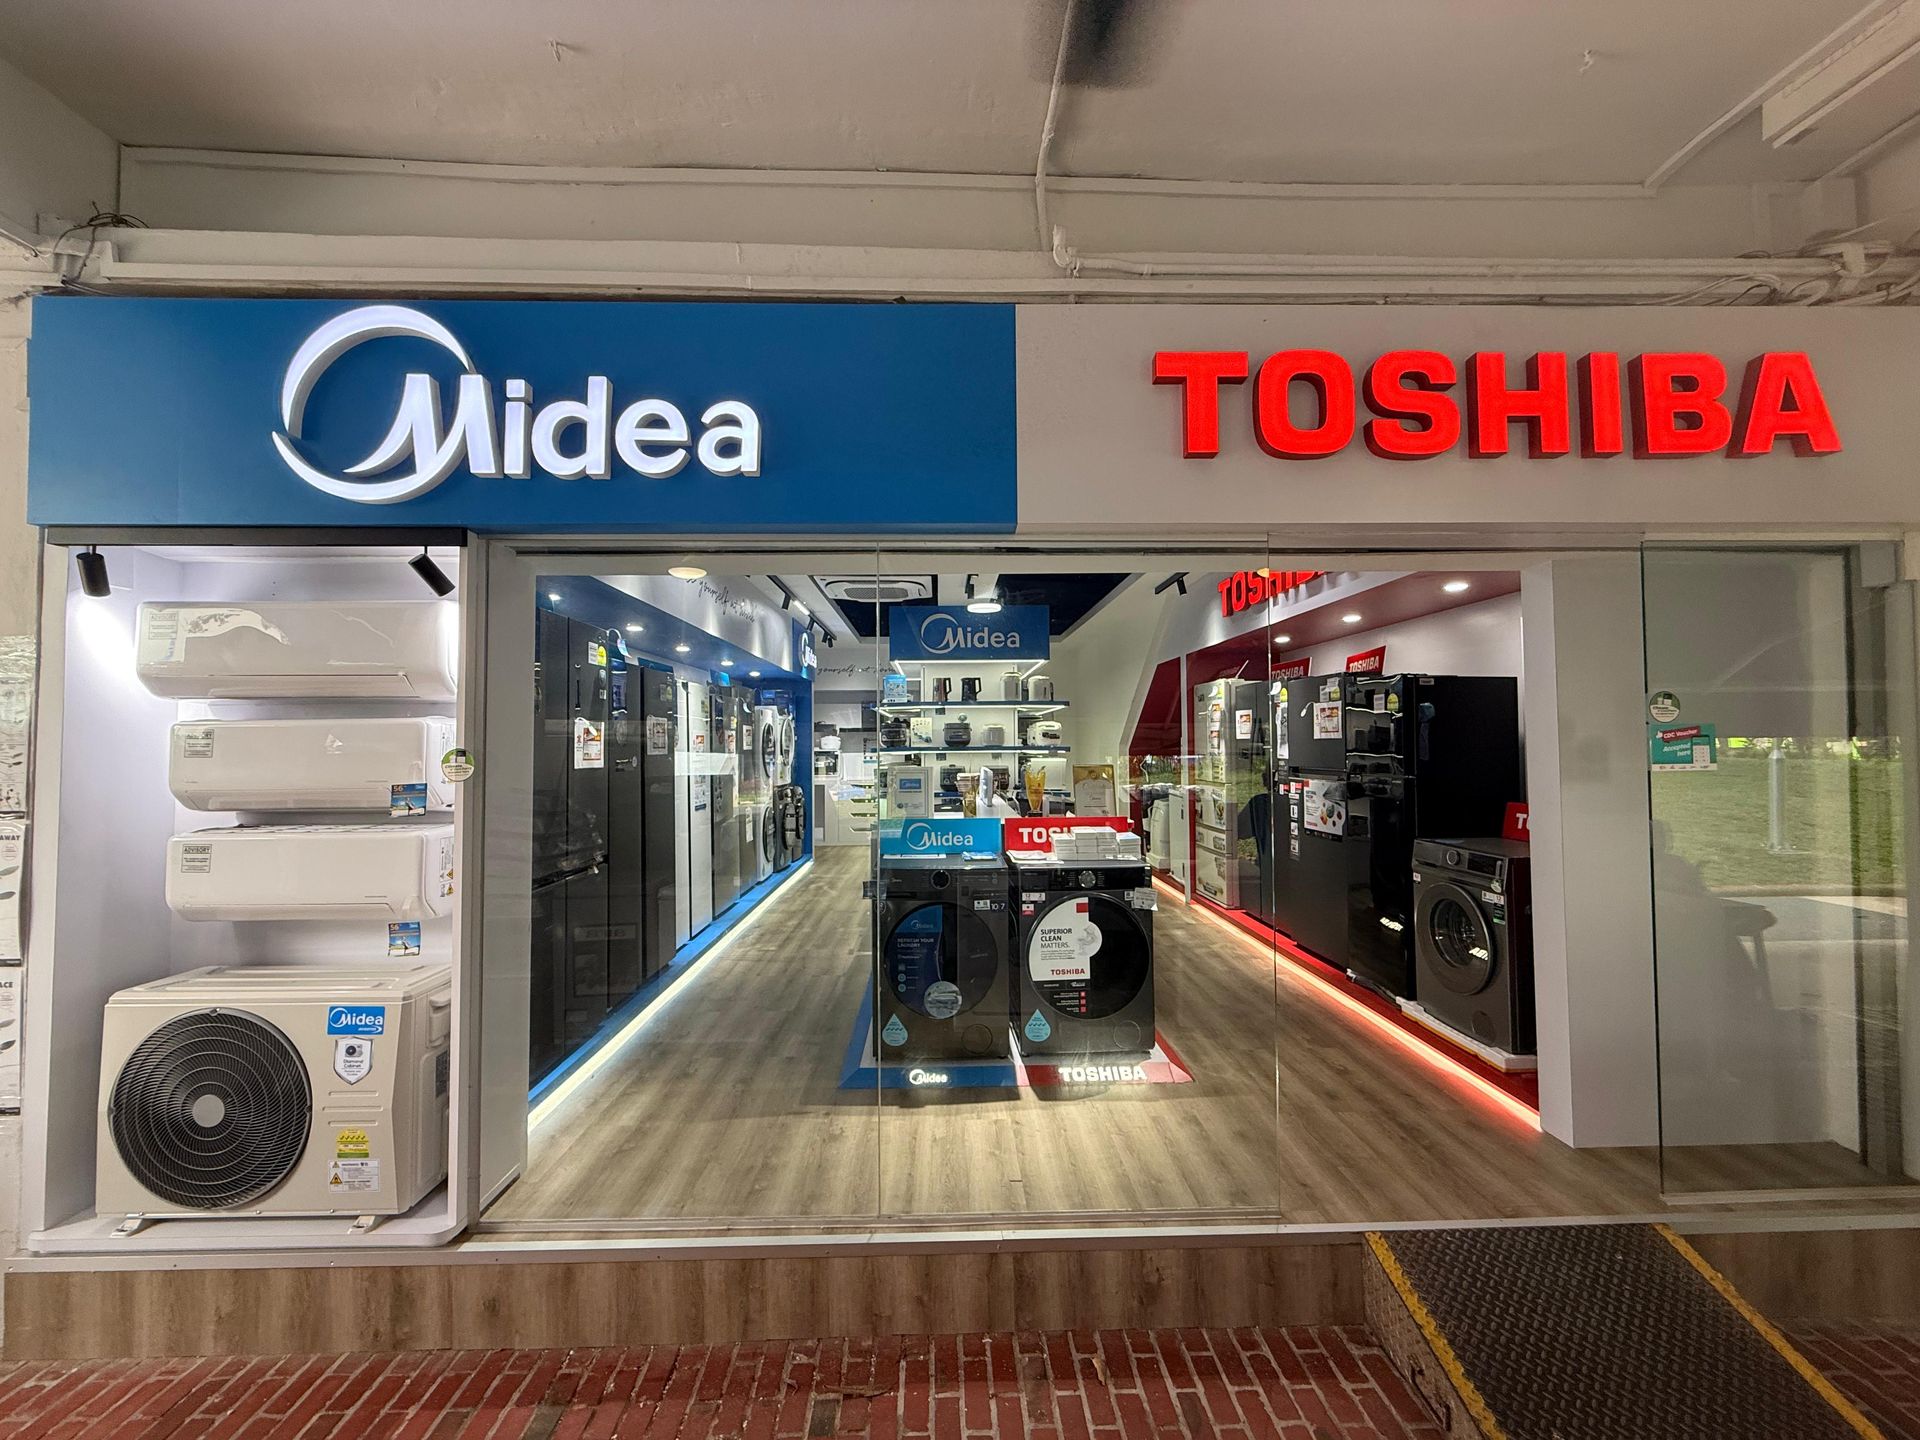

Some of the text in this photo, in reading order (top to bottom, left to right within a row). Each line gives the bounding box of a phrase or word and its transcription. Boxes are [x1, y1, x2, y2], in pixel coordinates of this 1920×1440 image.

[272, 305, 763, 504] Midea
[1153, 349, 1842, 459] TOSHIBA
[920, 613, 1020, 654] Midea
[1271, 665, 1304, 679] TOSHIBA
[1349, 655, 1380, 673] TOSHIBA
[1676, 728, 1698, 737] Voucher
[1663, 743, 1691, 752] Accepted
[906, 822, 974, 850] Midea
[1040, 941, 1071, 949] MATTERS.
[1050, 968, 1086, 976] TOSHIBA
[329, 1007, 384, 1028] Midea
[909, 1068, 949, 1085] Midea
[1058, 1065, 1148, 1082] TOSHIBA
